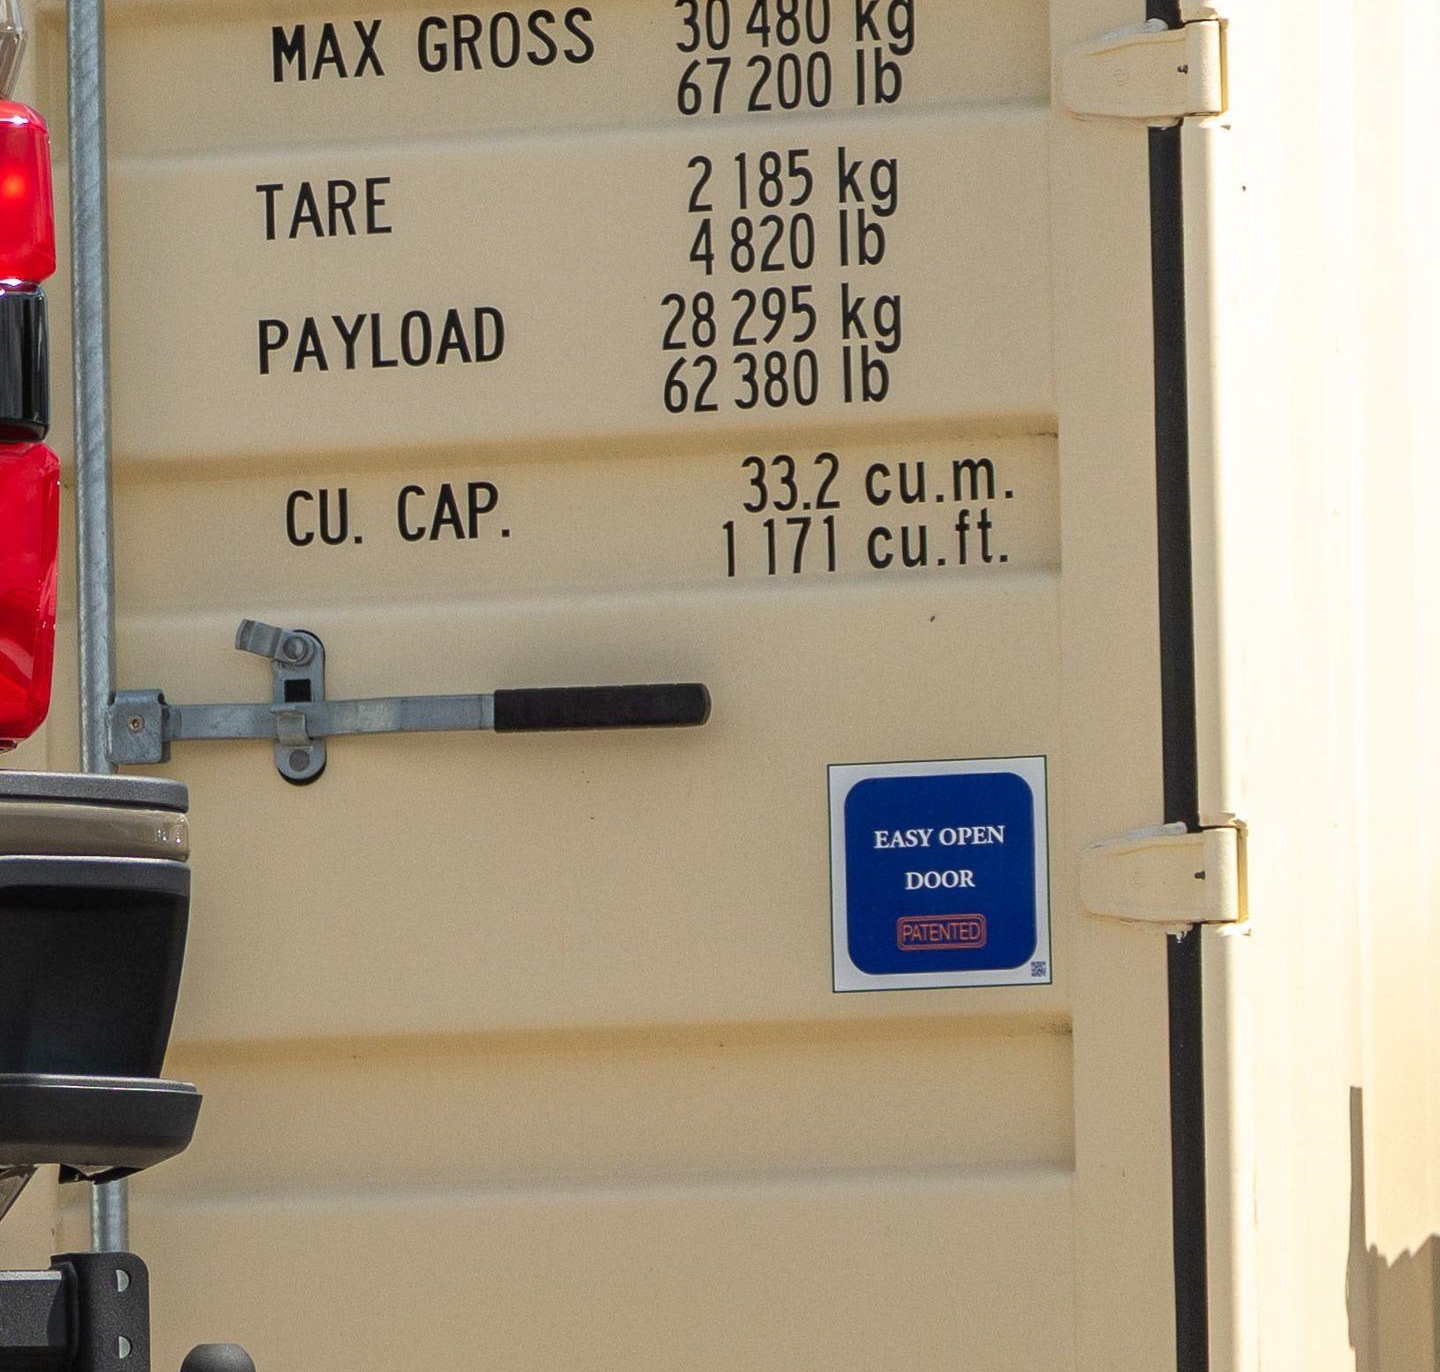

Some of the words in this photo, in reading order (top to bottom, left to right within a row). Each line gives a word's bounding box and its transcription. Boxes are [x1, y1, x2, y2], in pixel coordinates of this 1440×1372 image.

[271, 19, 385, 83] MAX
[417, 6, 595, 73] GROSS
[856, 51, 903, 106] lb
[255, 176, 392, 241] TARE
[837, 146, 899, 217] kg
[839, 213, 886, 267] lb
[258, 306, 505, 375] PAYLOAD
[840, 282, 902, 353] kg
[842, 345, 891, 403] lb
[286, 487, 363, 547] CU.
[397, 481, 510, 542] CAP.
[741, 451, 841, 513] 33.2
[865, 457, 1014, 507] cu.m.
[867, 507, 1008, 570] cu.ft.
[873, 828, 933, 849] EASY
[939, 825, 1005, 846] OPEN
[905, 869, 975, 890] DOOR
[902, 921, 981, 943] PATENTED
